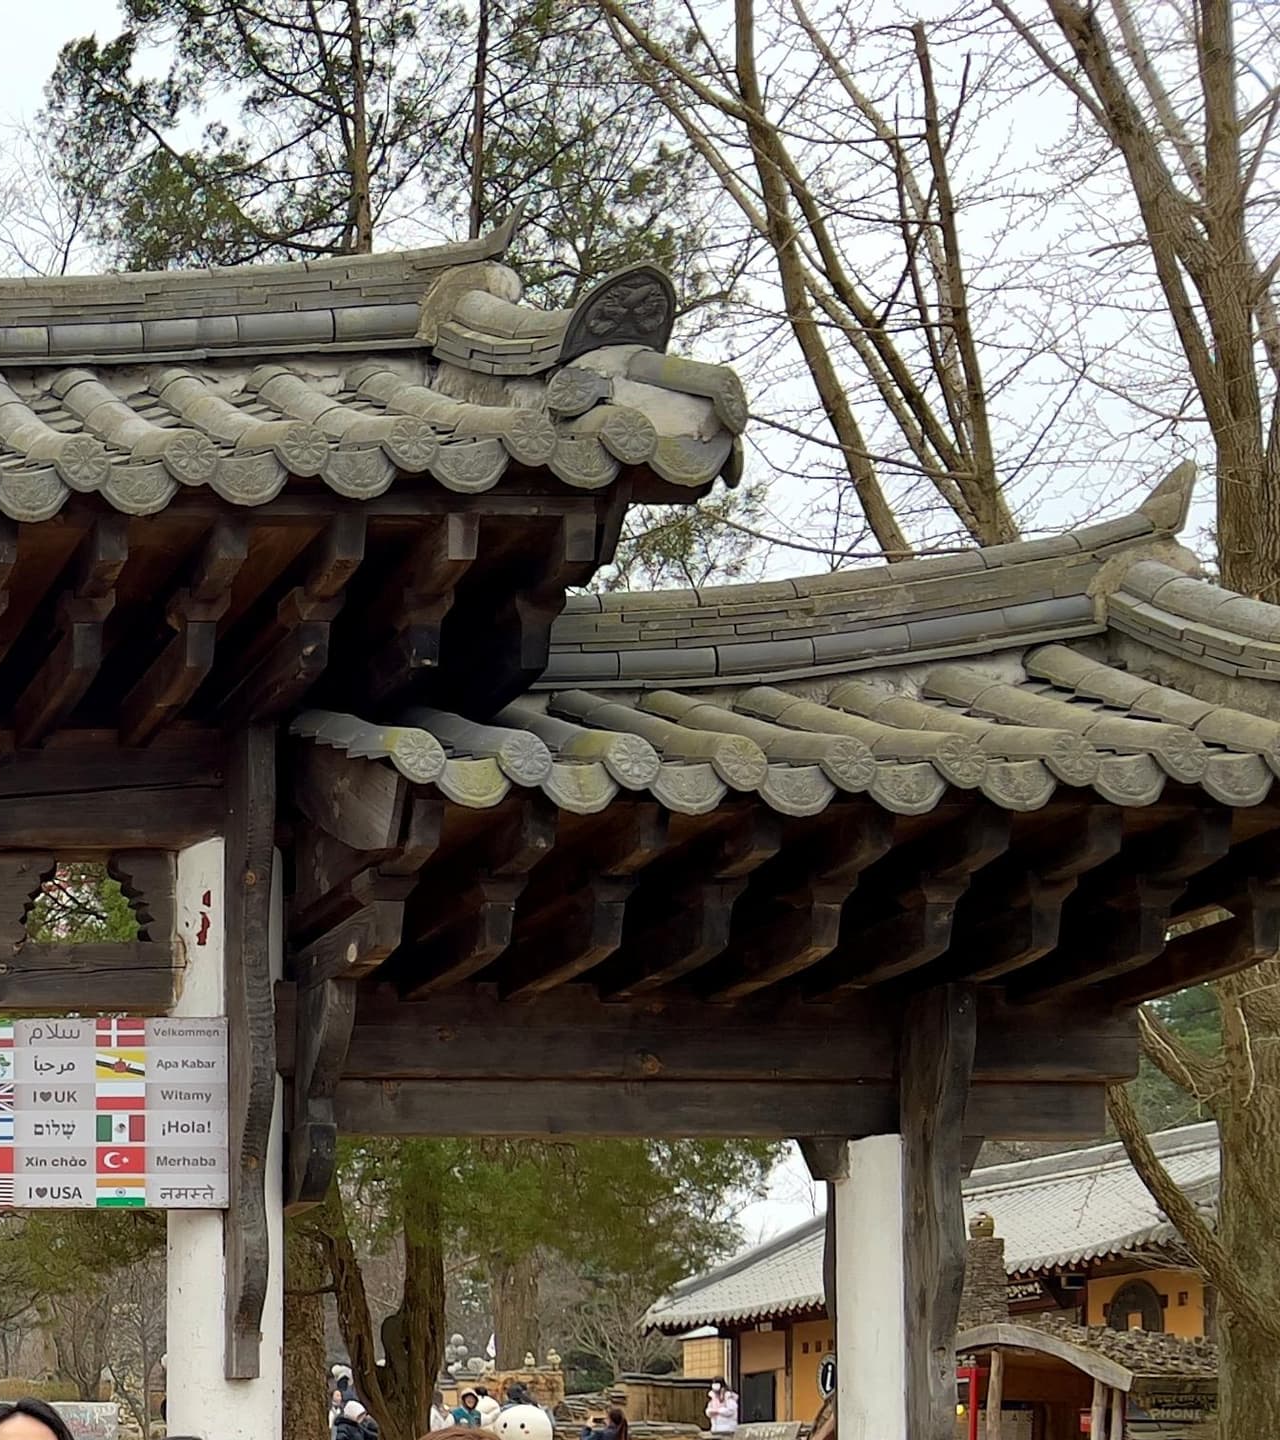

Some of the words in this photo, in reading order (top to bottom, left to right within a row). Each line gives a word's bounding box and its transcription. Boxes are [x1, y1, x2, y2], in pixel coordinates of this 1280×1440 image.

[28, 1022, 80, 1045] سلام
[153, 1027, 220, 1038] Velkommen
[156, 1058, 179, 1070] Apa
[181, 1058, 216, 1069] Kabar
[160, 1090, 212, 1103] Witamy
[161, 1120, 212, 1136] ¡Hola!
[25, 1156, 48, 1167] Xin
[51, 1155, 88, 1168] chào
[155, 1155, 217, 1167] Merhaba
[50, 1186, 83, 1199] USA
[160, 1184, 216, 1200] नमस्ते
